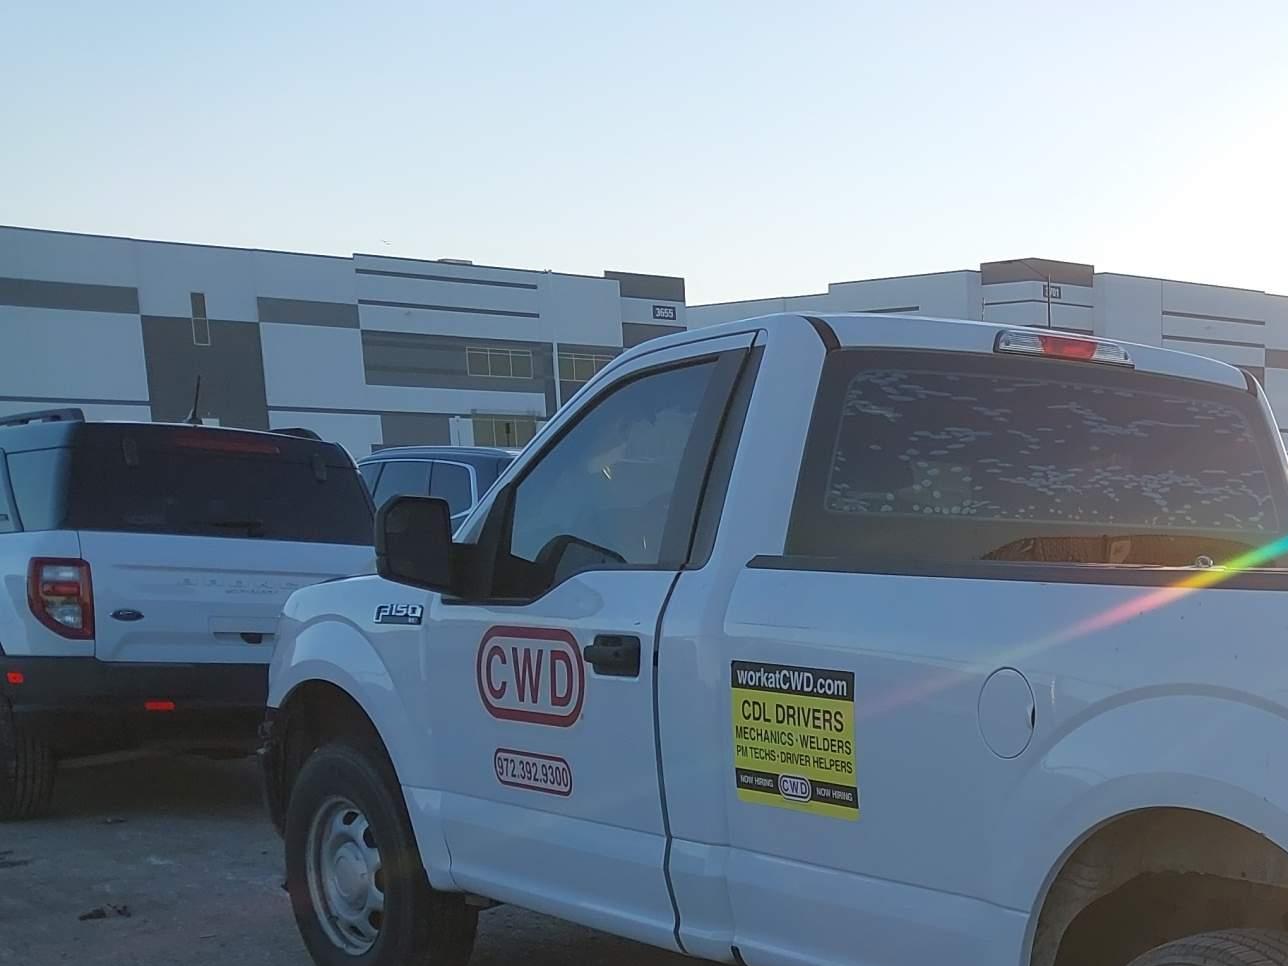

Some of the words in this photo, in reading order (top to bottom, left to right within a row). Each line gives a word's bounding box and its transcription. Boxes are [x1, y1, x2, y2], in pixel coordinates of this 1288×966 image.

[655, 307, 675, 318] 3655
[486, 645, 574, 707] CWD
[737, 668, 848, 697] workatCWD.com
[741, 699, 772, 723] CDL
[775, 703, 844, 733] DRIVERS
[735, 725, 795, 747] MECHANICS
[799, 734, 853, 756] WELDERS
[497, 756, 570, 788] 972.392.9300
[736, 744, 749, 758] PM
[749, 746, 776, 762] TECHS
[780, 751, 811, 767] DRIVER
[812, 756, 854, 774] HELPERS
[740, 774, 755, 785] NOW
[754, 777, 774, 788] HIRING
[782, 779, 808, 795] CWD
[816, 787, 831, 798] NOW
[832, 789, 853, 801] HIRING
